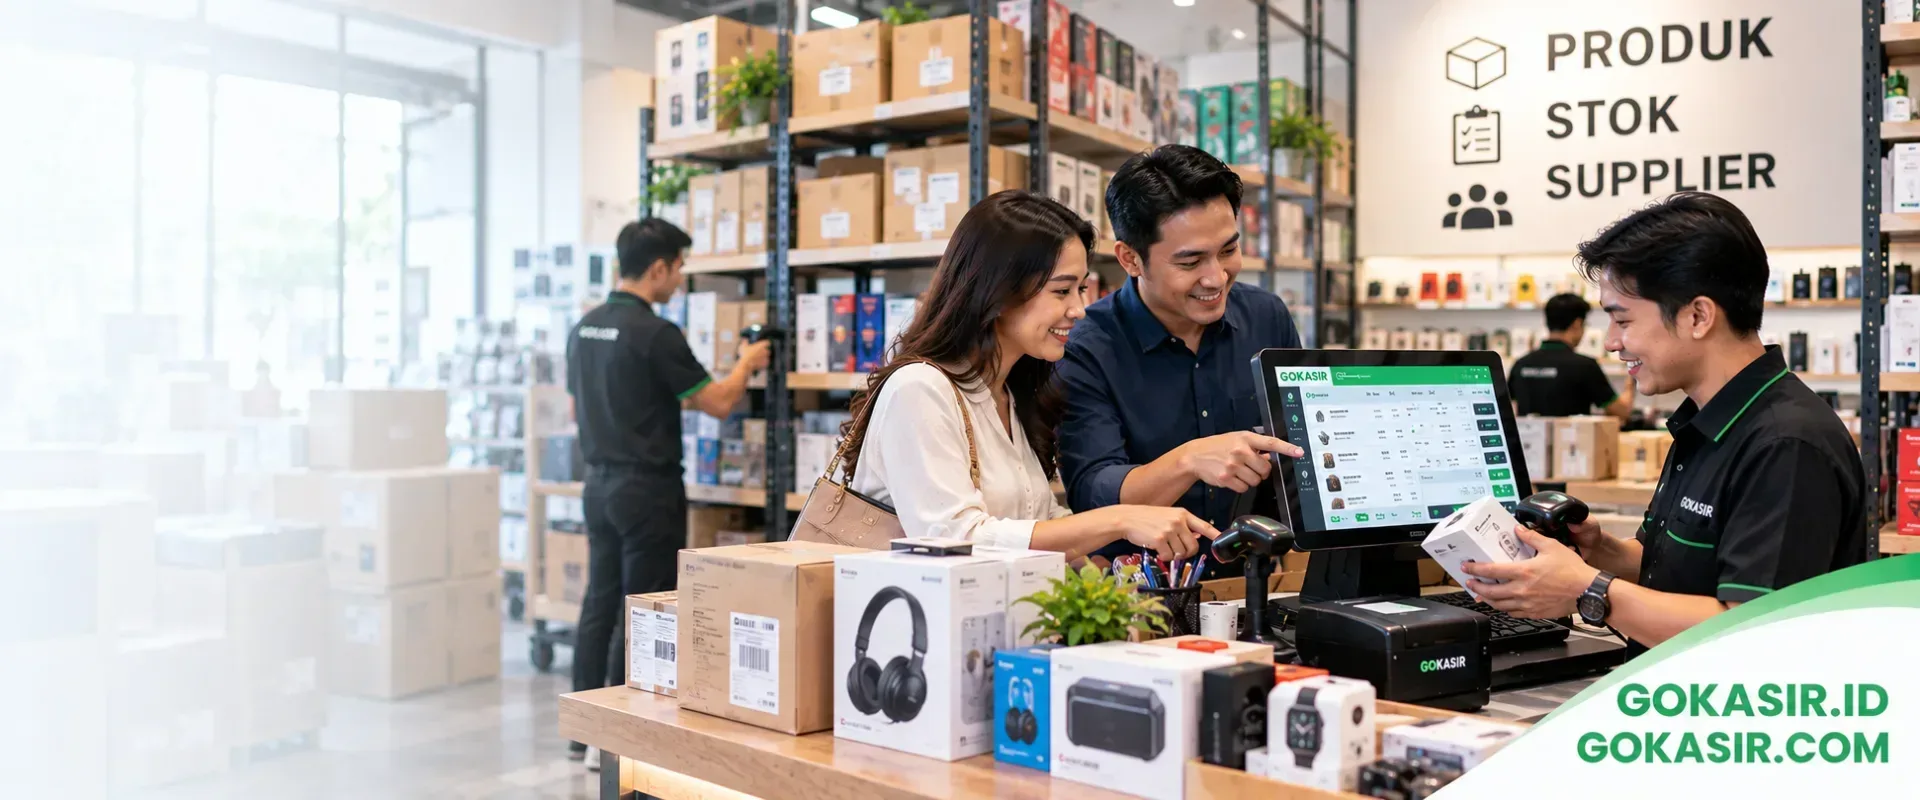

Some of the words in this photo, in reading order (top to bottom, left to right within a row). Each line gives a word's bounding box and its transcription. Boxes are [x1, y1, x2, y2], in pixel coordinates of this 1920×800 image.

[1548, 17, 1773, 71] PRODUK
[1546, 95, 1680, 139] STOK
[1546, 152, 1776, 200] SUPPLIER
[1280, 371, 1328, 382] GOKASIR
[1680, 496, 1714, 518] GOKASIR
[1420, 656, 1466, 673] GOKASIR
